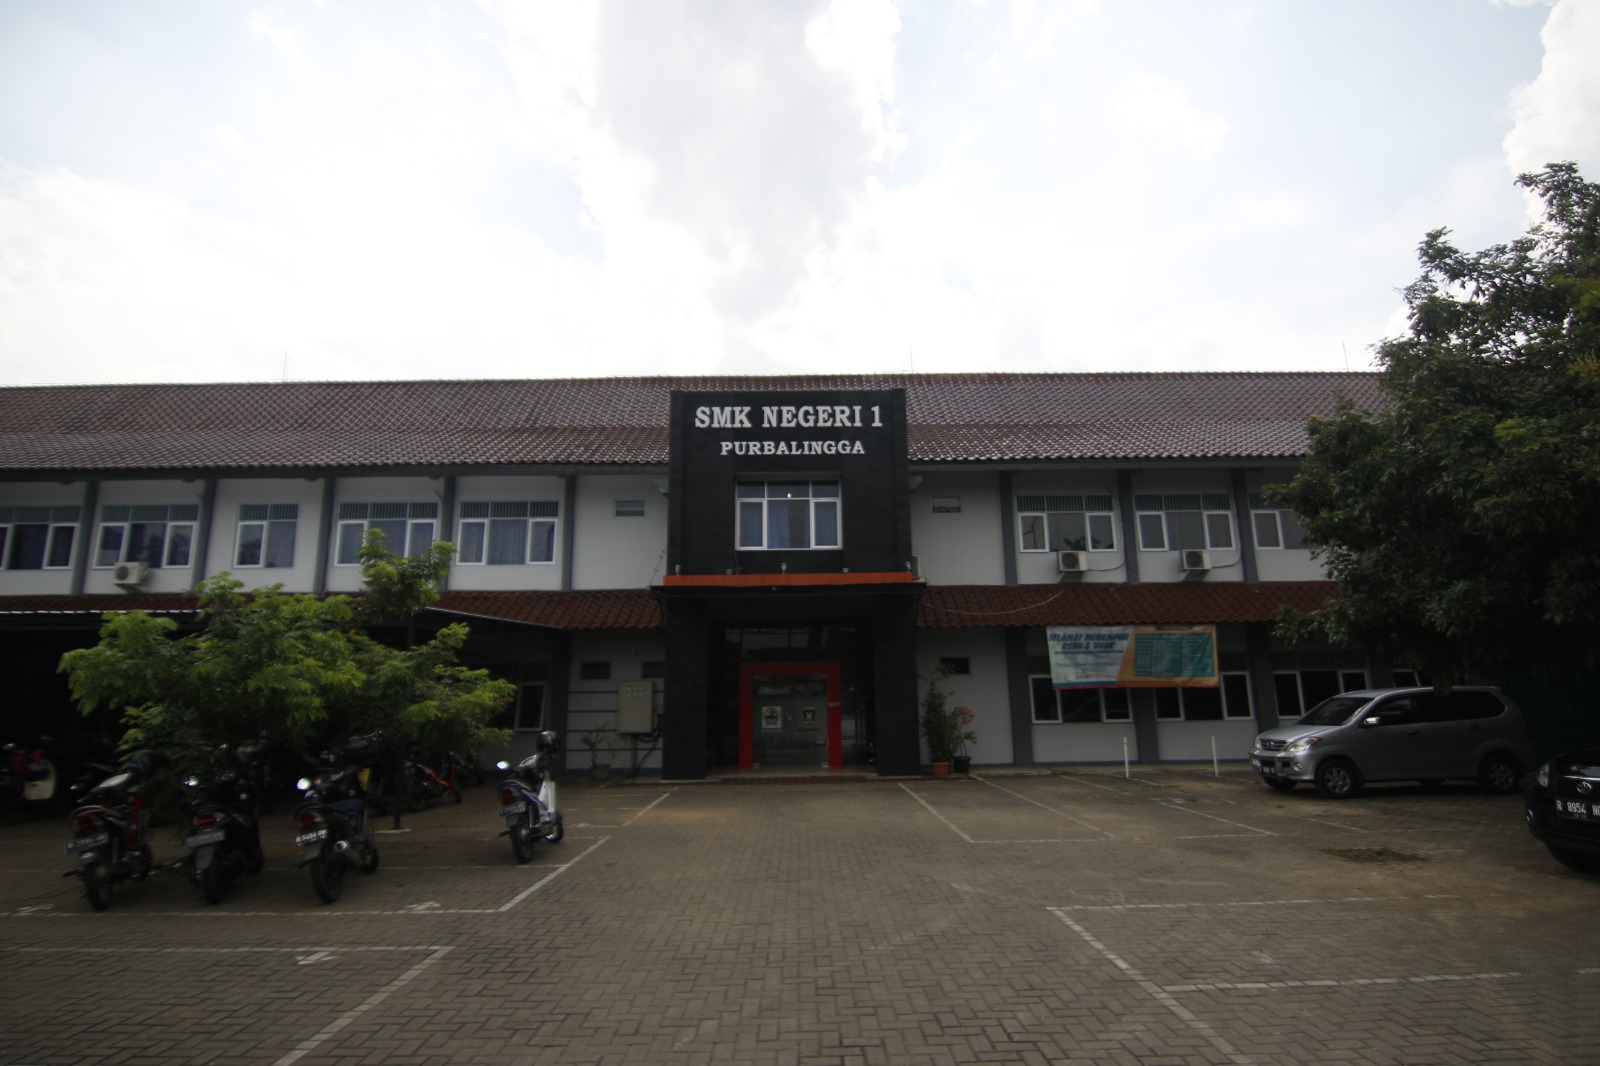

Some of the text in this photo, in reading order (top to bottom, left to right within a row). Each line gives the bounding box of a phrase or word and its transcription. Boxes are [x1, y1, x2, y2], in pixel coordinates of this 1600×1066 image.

[694, 405, 884, 429] SMK NEGERI 1
[719, 440, 865, 456] PURBALINGGA
[1049, 633, 1083, 642] SELAMAT
[1556, 800, 1562, 811] R
[1566, 801, 1586, 813] 8954
